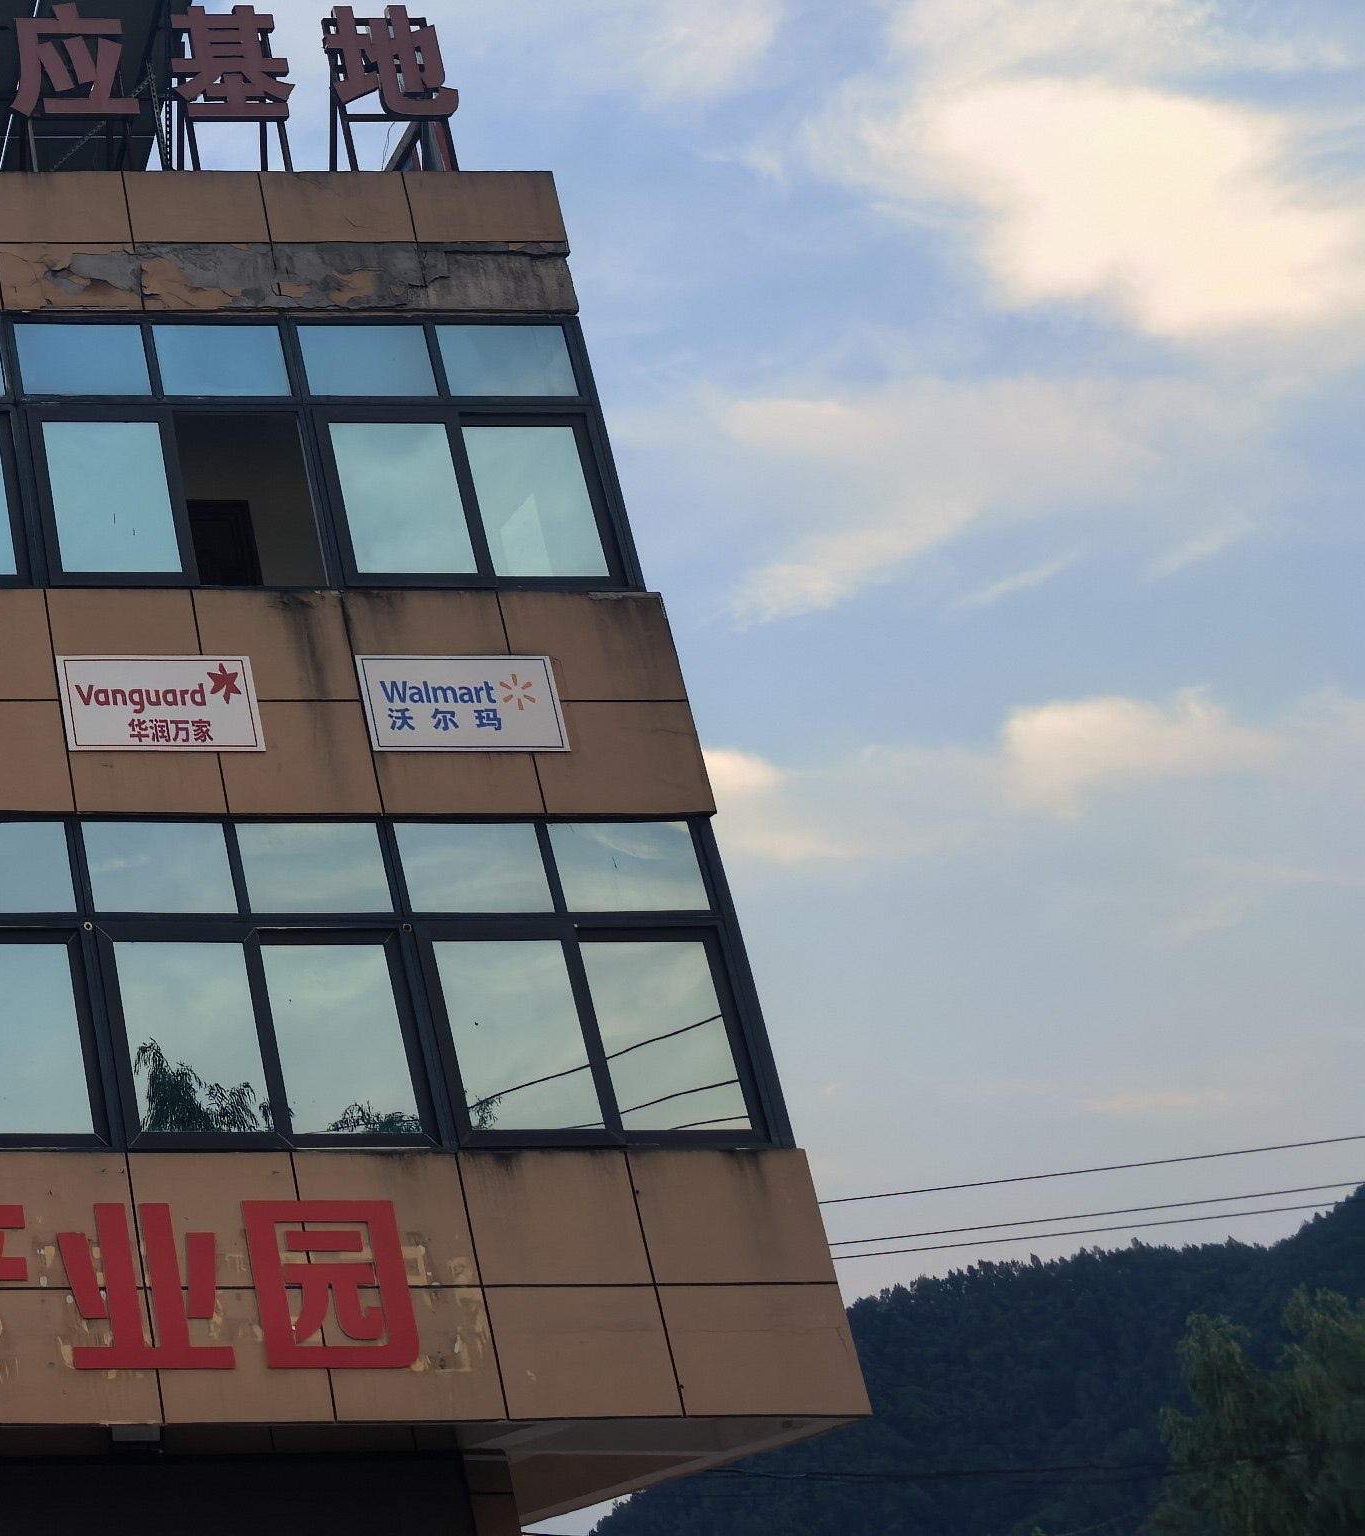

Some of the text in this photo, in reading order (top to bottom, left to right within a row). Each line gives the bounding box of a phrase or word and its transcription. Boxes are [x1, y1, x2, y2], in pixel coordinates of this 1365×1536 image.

[74, 682, 207, 714] Vanguard
[379, 680, 497, 704] Walmart
[127, 718, 214, 743] 华润万家
[387, 707, 502, 731] 沃尔玛
